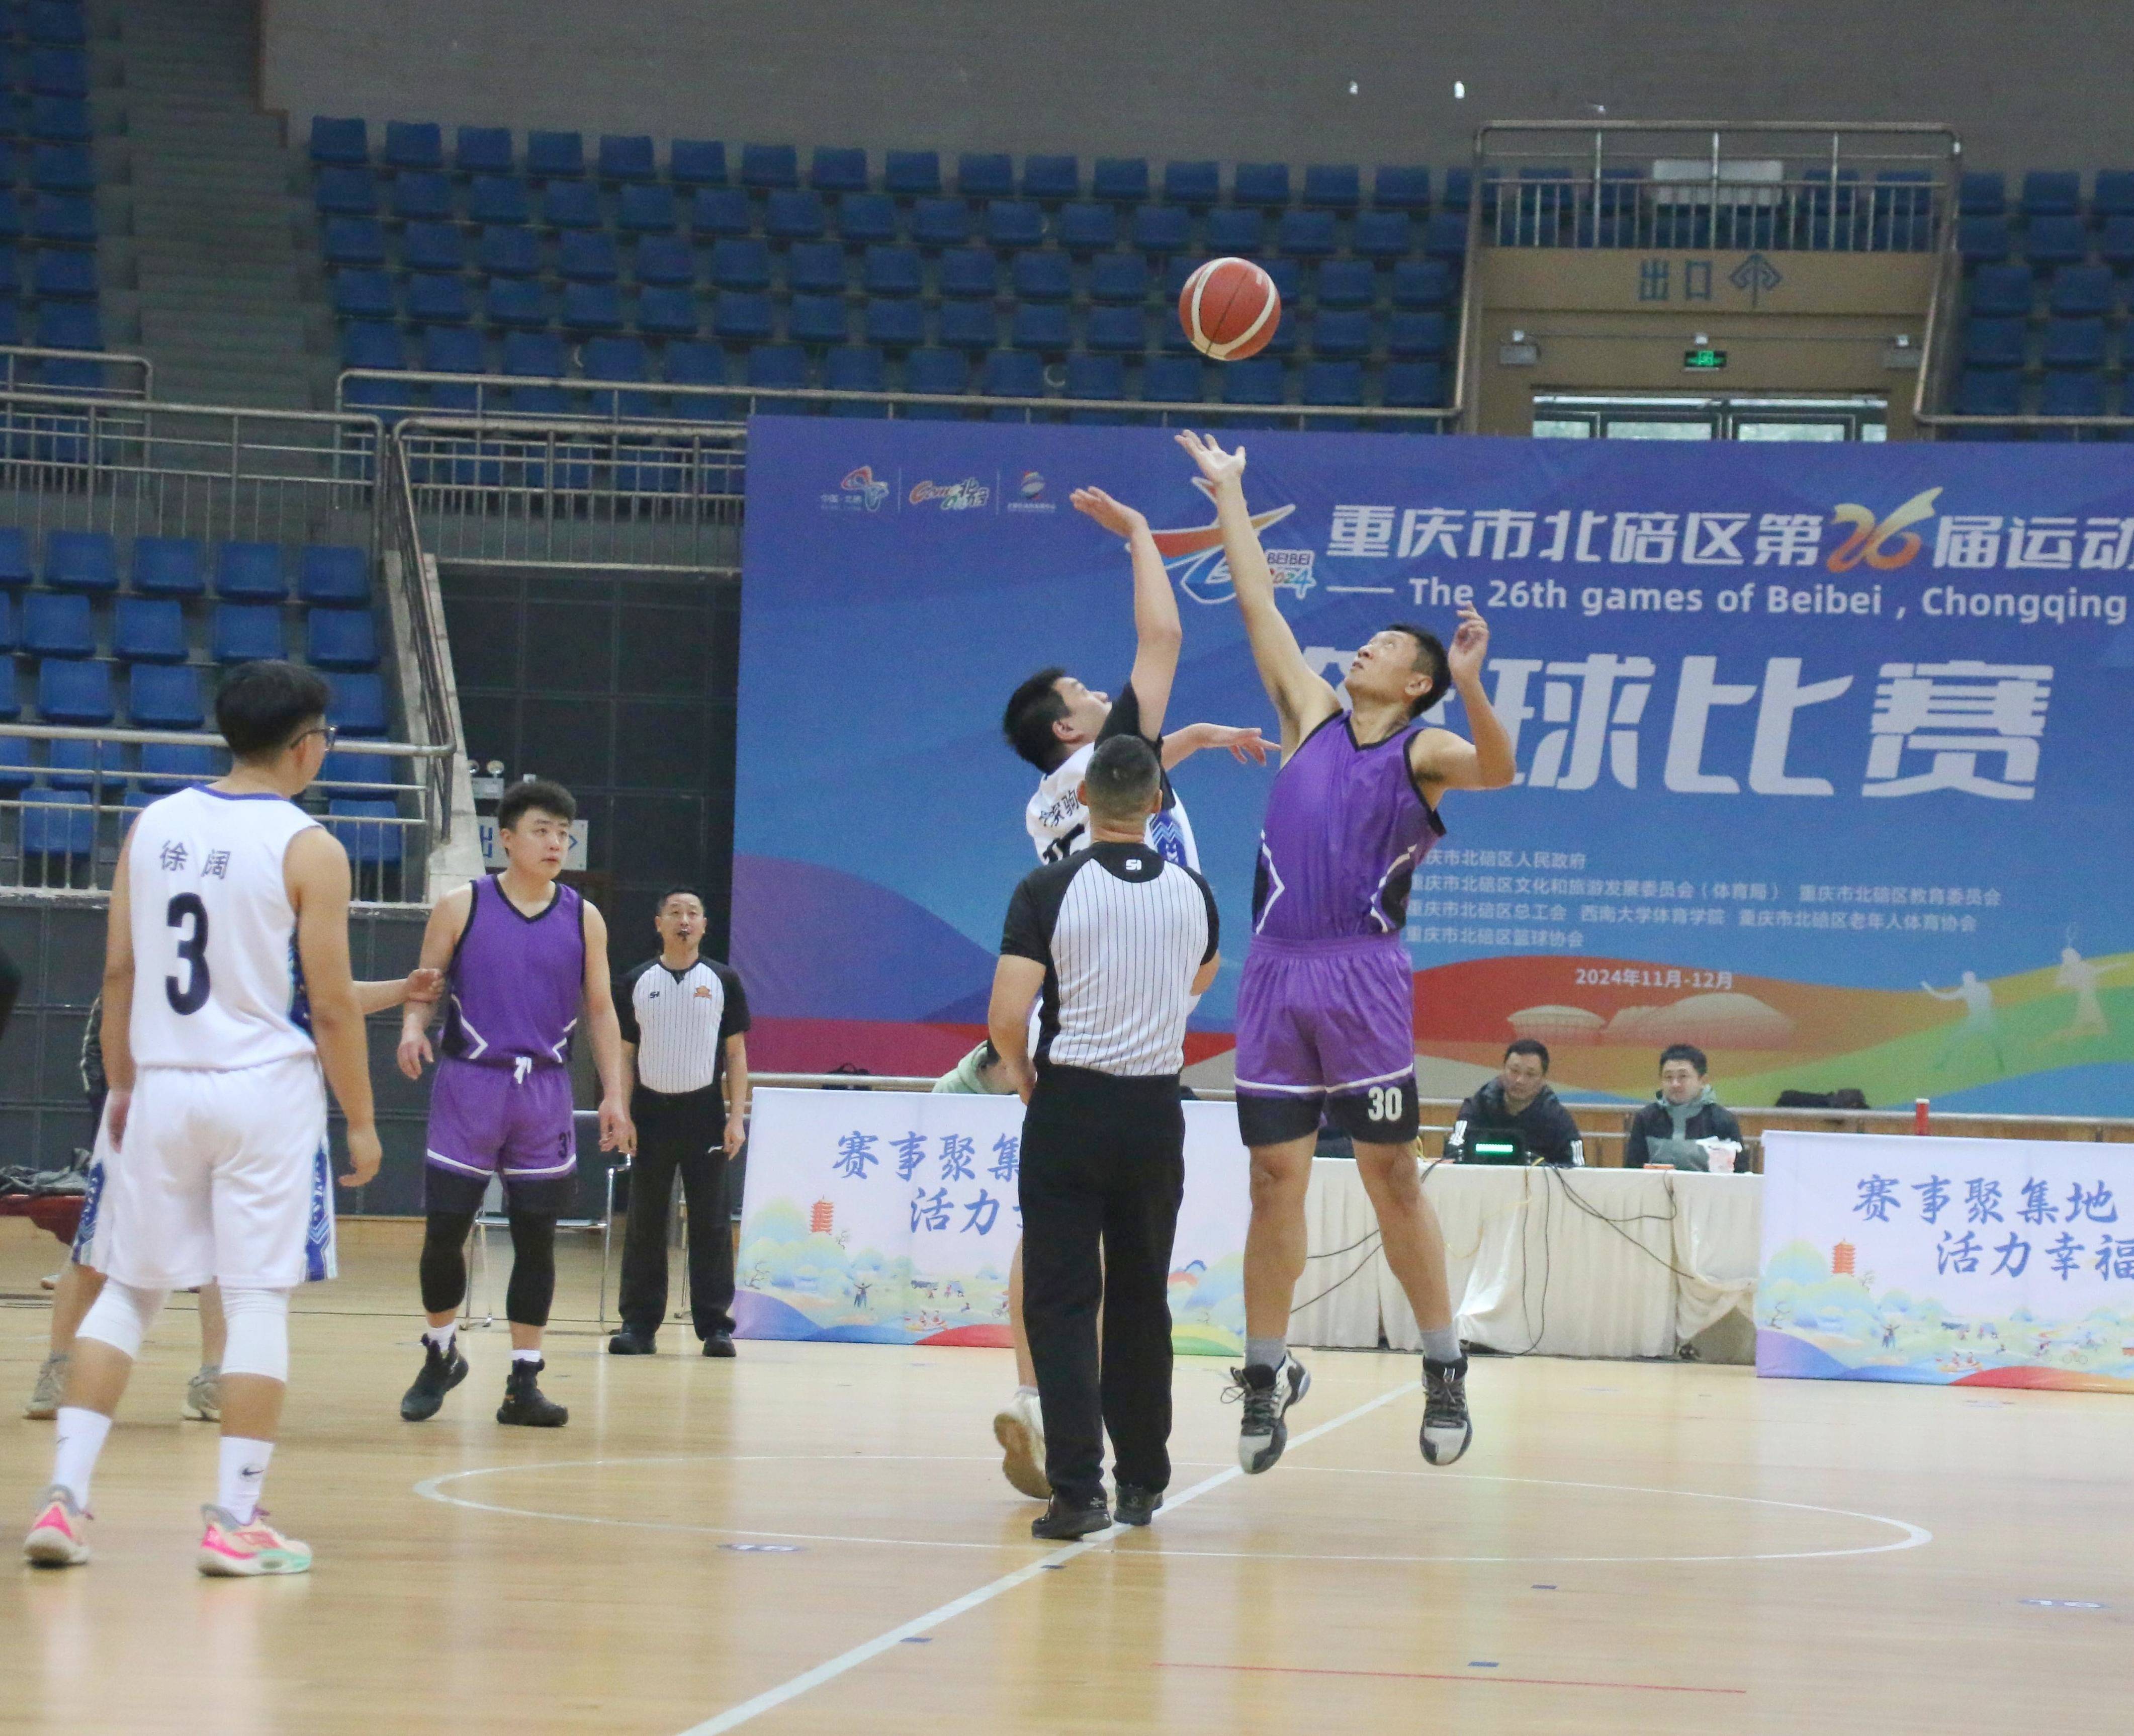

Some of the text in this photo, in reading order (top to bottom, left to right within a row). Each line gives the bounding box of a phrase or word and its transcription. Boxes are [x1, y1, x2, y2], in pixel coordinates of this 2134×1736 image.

[1638, 258, 1712, 301] 出口
[1268, 555, 1309, 565] BEIBEI
[1270, 568, 1315, 597] 024
[1410, 577, 1474, 606] The
[1488, 580, 1567, 608] 26th
[1581, 587, 1703, 616] games
[1717, 582, 1755, 613] of
[1767, 584, 1882, 615] Beibei
[1922, 585, 2127, 625] Chongqing
[1425, 849, 1586, 869] 庆市北碚区人民政府
[165, 892, 211, 1016] 3
[1368, 1086, 1403, 1122] 30
[909, 1187, 1024, 1236] 活力
[1852, 1173, 2119, 1225] 赛事聚集地
[1936, 1230, 2134, 1281] 活力幸福
